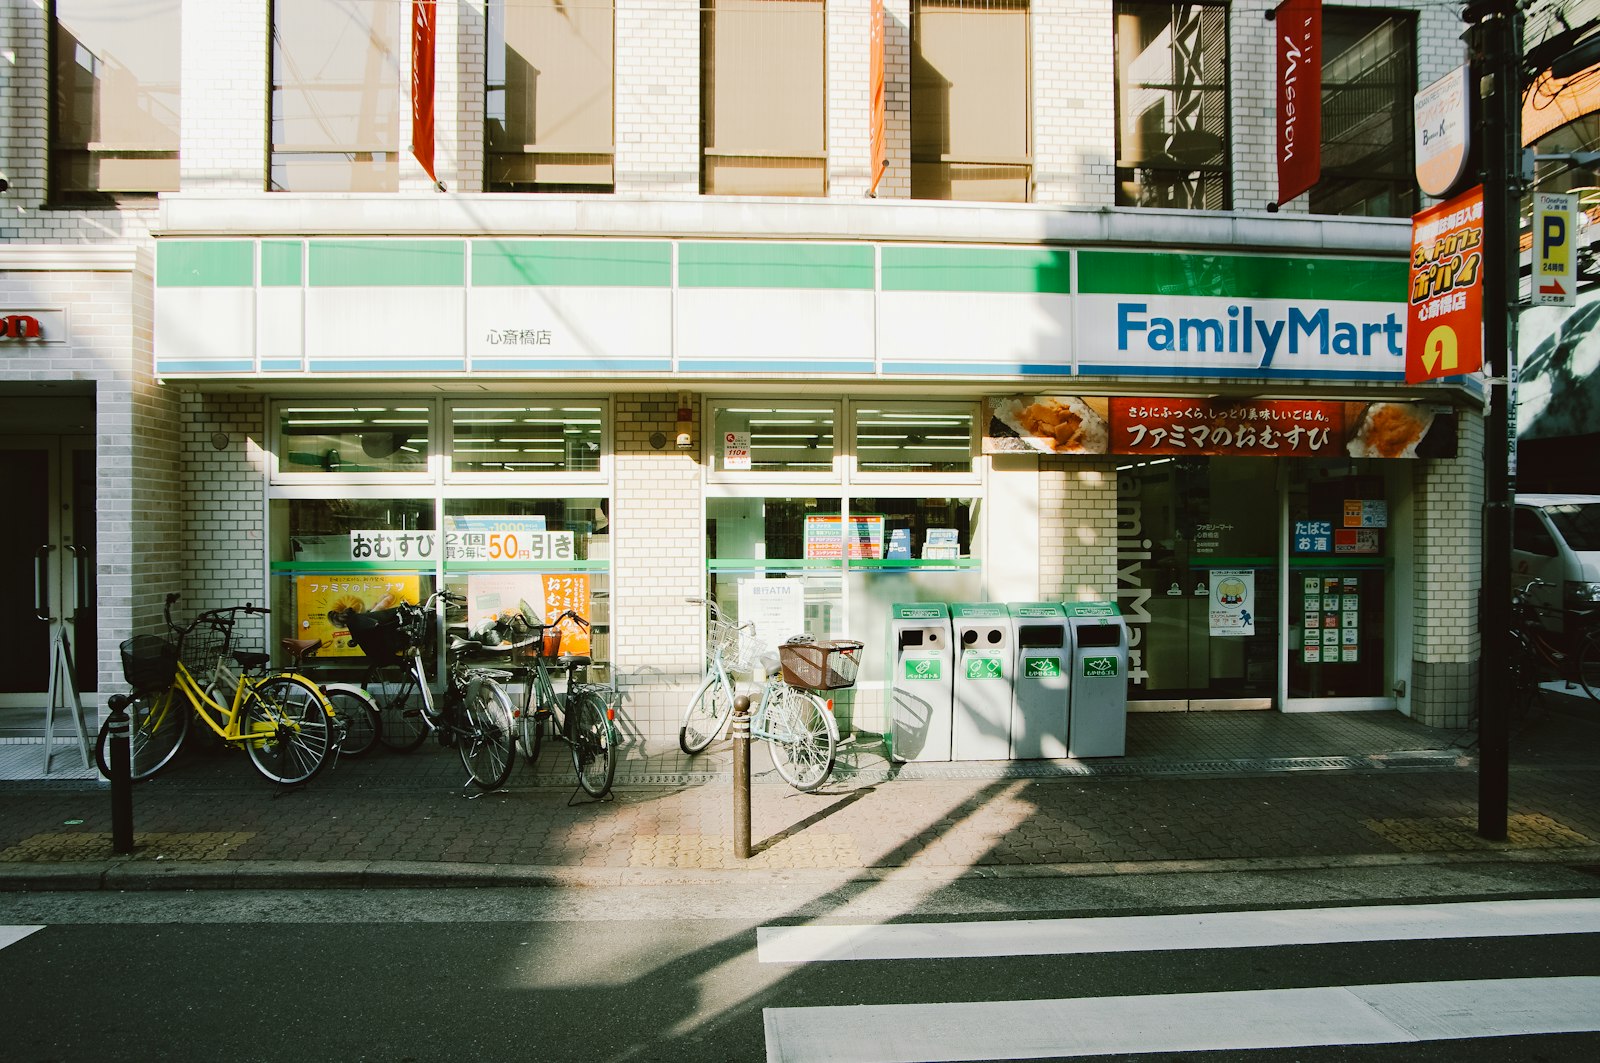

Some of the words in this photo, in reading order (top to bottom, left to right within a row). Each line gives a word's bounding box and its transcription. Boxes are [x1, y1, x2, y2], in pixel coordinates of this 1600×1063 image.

[1304, 17, 1312, 63] hair
[1284, 36, 1301, 162] Mission
[1414, 227, 1482, 269] ネットカフェ
[1543, 216, 1565, 259] P
[1411, 252, 1481, 305] ポパイ
[1543, 263, 1564, 272] 24時間
[487, 329, 552, 345] 心斎橋店
[1117, 303, 1403, 368] FamilyMart
[1126, 423, 1330, 451] ファミマのおむすび
[446, 533, 485, 546] 2個
[1295, 522, 1331, 535] たばこ
[353, 533, 435, 558] おむすび
[446, 546, 486, 559] 買う毎に
[310, 582, 405, 593] ファミマのドーナツ
[753, 586, 791, 594] 銀行ATM
